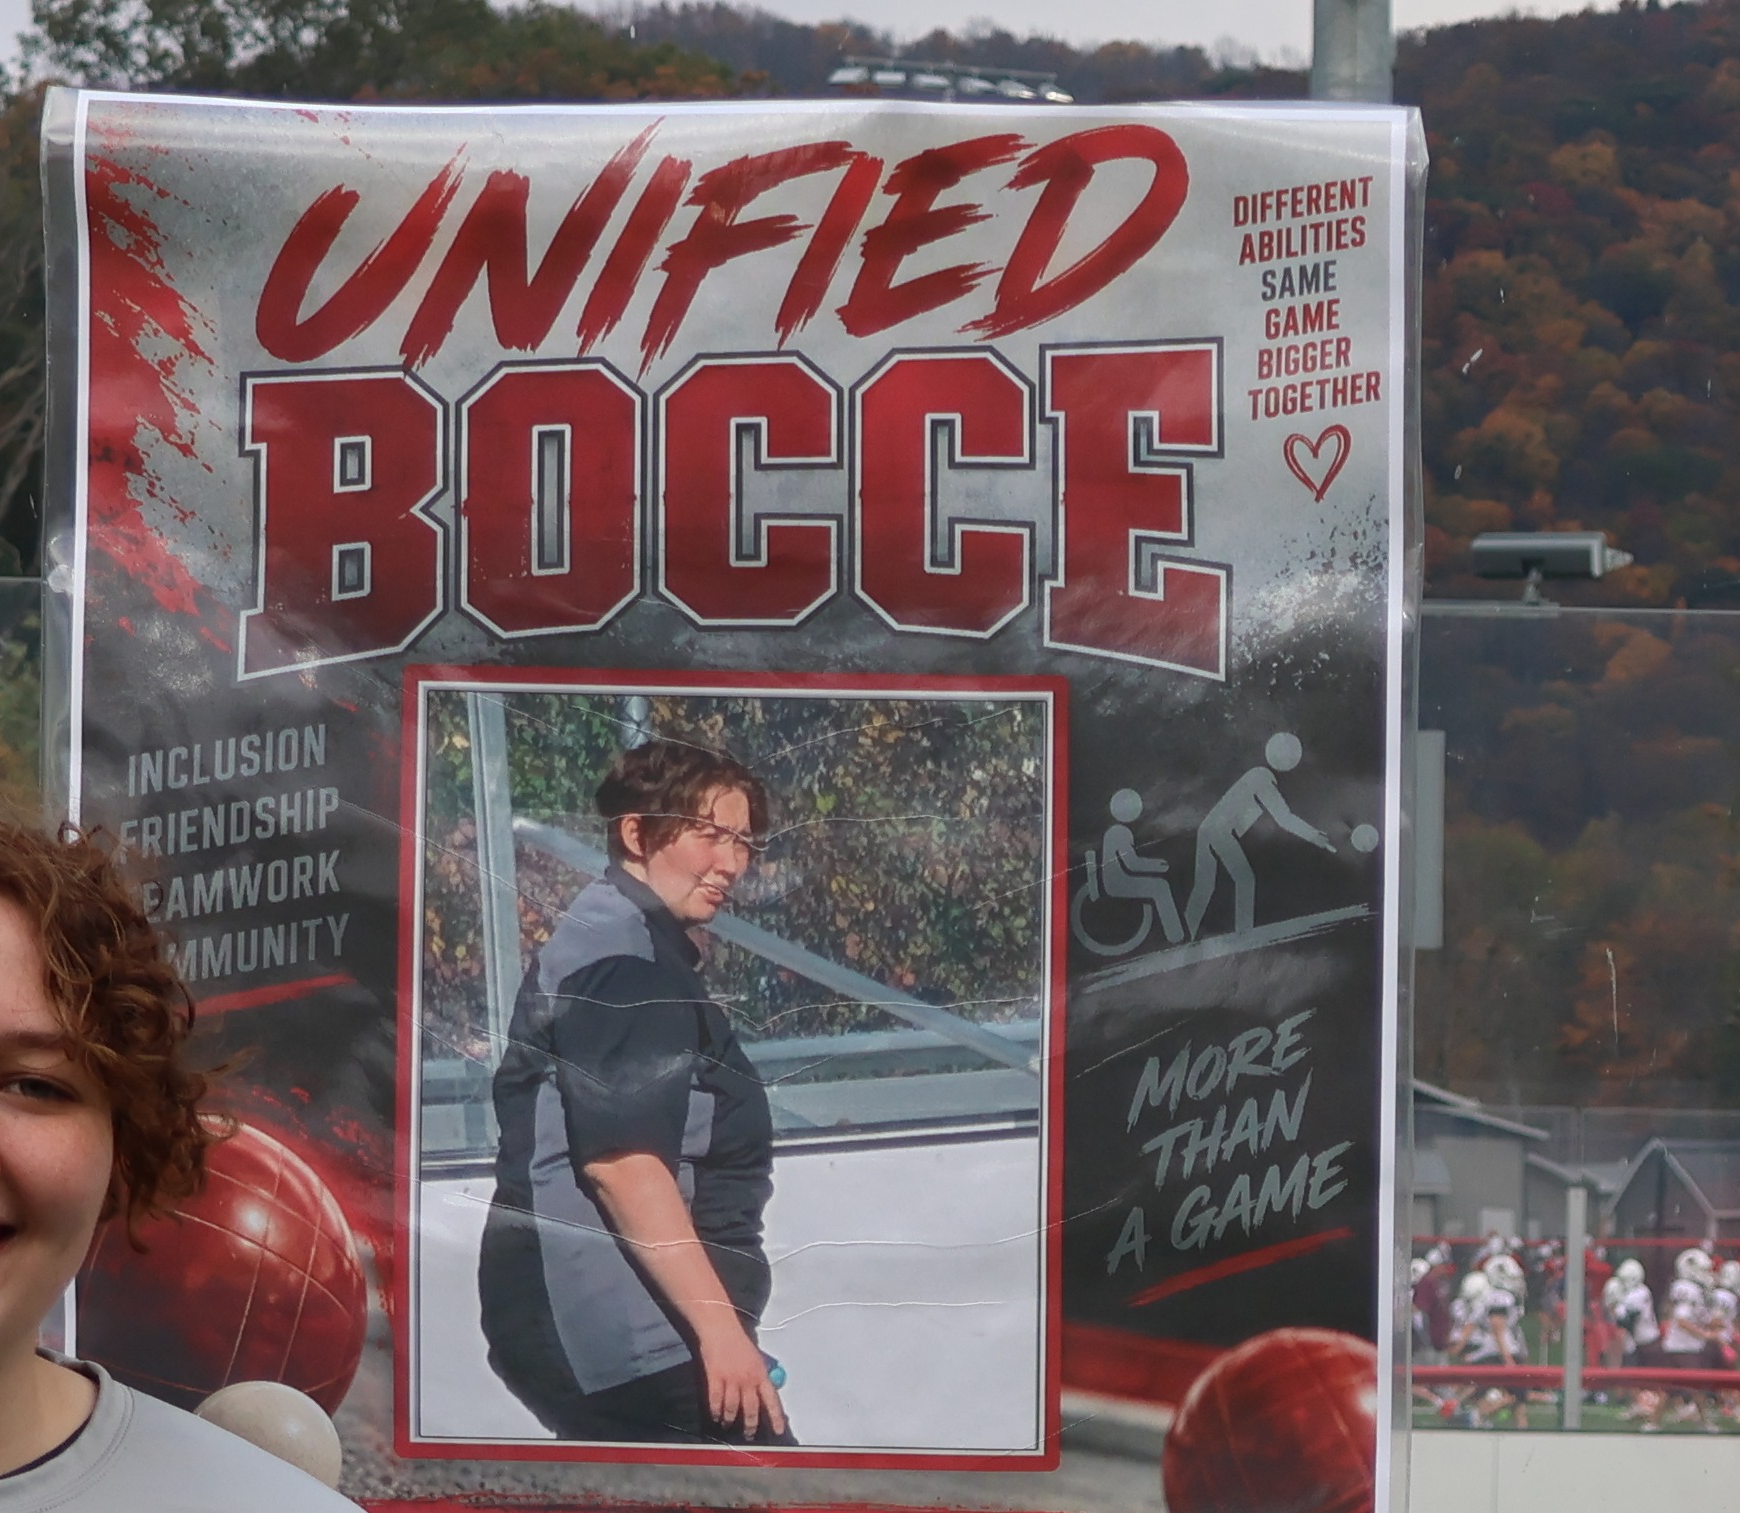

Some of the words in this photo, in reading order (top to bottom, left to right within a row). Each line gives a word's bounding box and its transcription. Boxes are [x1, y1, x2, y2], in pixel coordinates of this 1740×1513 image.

[1233, 176, 1374, 227] DIFFERENT
[256, 118, 1190, 378] UNIFIED
[1238, 215, 1366, 265] ABILITIES
[1261, 260, 1337, 301] SAME
[1265, 298, 1340, 340] GAME
[1248, 370, 1381, 420] TOGETHER
[1258, 336, 1351, 380] BIGGER
[237, 336, 1229, 684] BOCCE
[128, 723, 326, 797] INCLUSION
[118, 786, 339, 865] FRIENDSHIP
[142, 849, 341, 924] EAMWORK
[166, 912, 350, 983] MMUNITY
[1126, 1007, 1317, 1134] MORE
[1139, 1066, 1314, 1192] THAN
[1106, 1206, 1153, 1277] A
[1170, 1140, 1356, 1251] GAME
